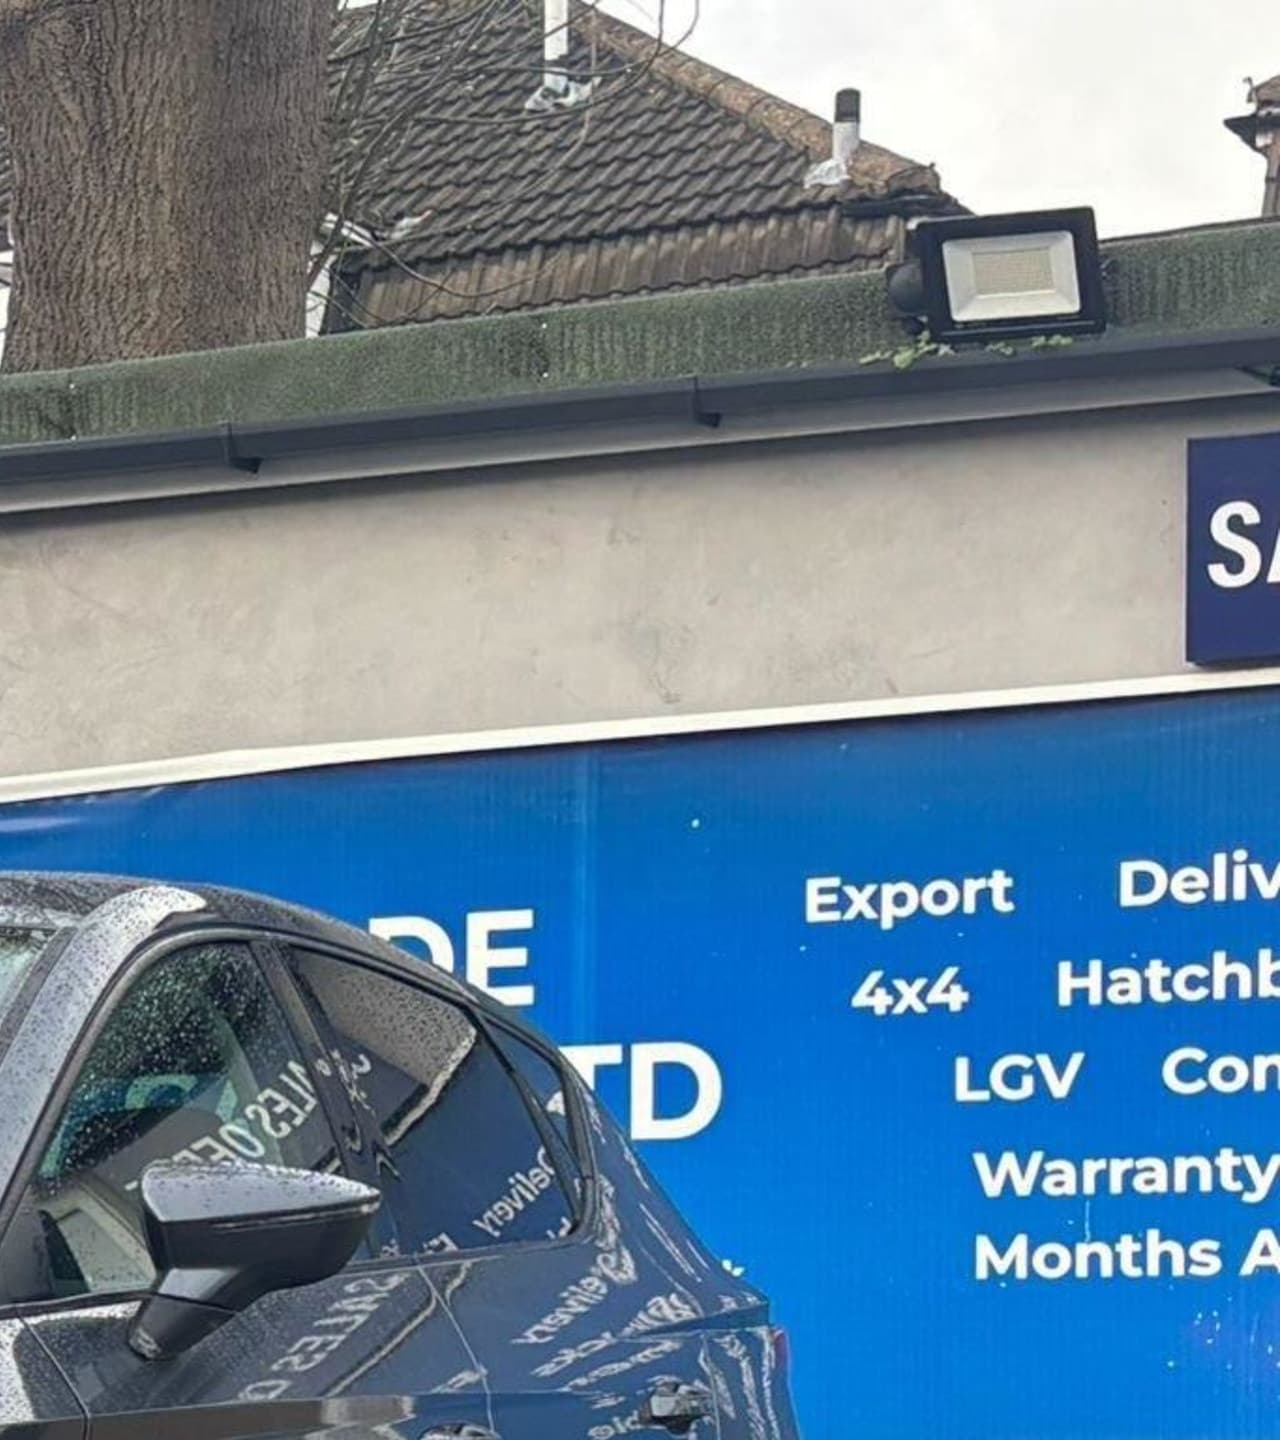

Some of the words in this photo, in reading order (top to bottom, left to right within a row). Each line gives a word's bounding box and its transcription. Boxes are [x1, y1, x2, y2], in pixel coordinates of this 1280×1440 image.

[805, 869, 1015, 930] Export
[850, 966, 970, 1016] 4x4
[954, 1051, 1086, 1102] LGV
[972, 1147, 1280, 1204] Warranty
[974, 1228, 1223, 1281] Months
